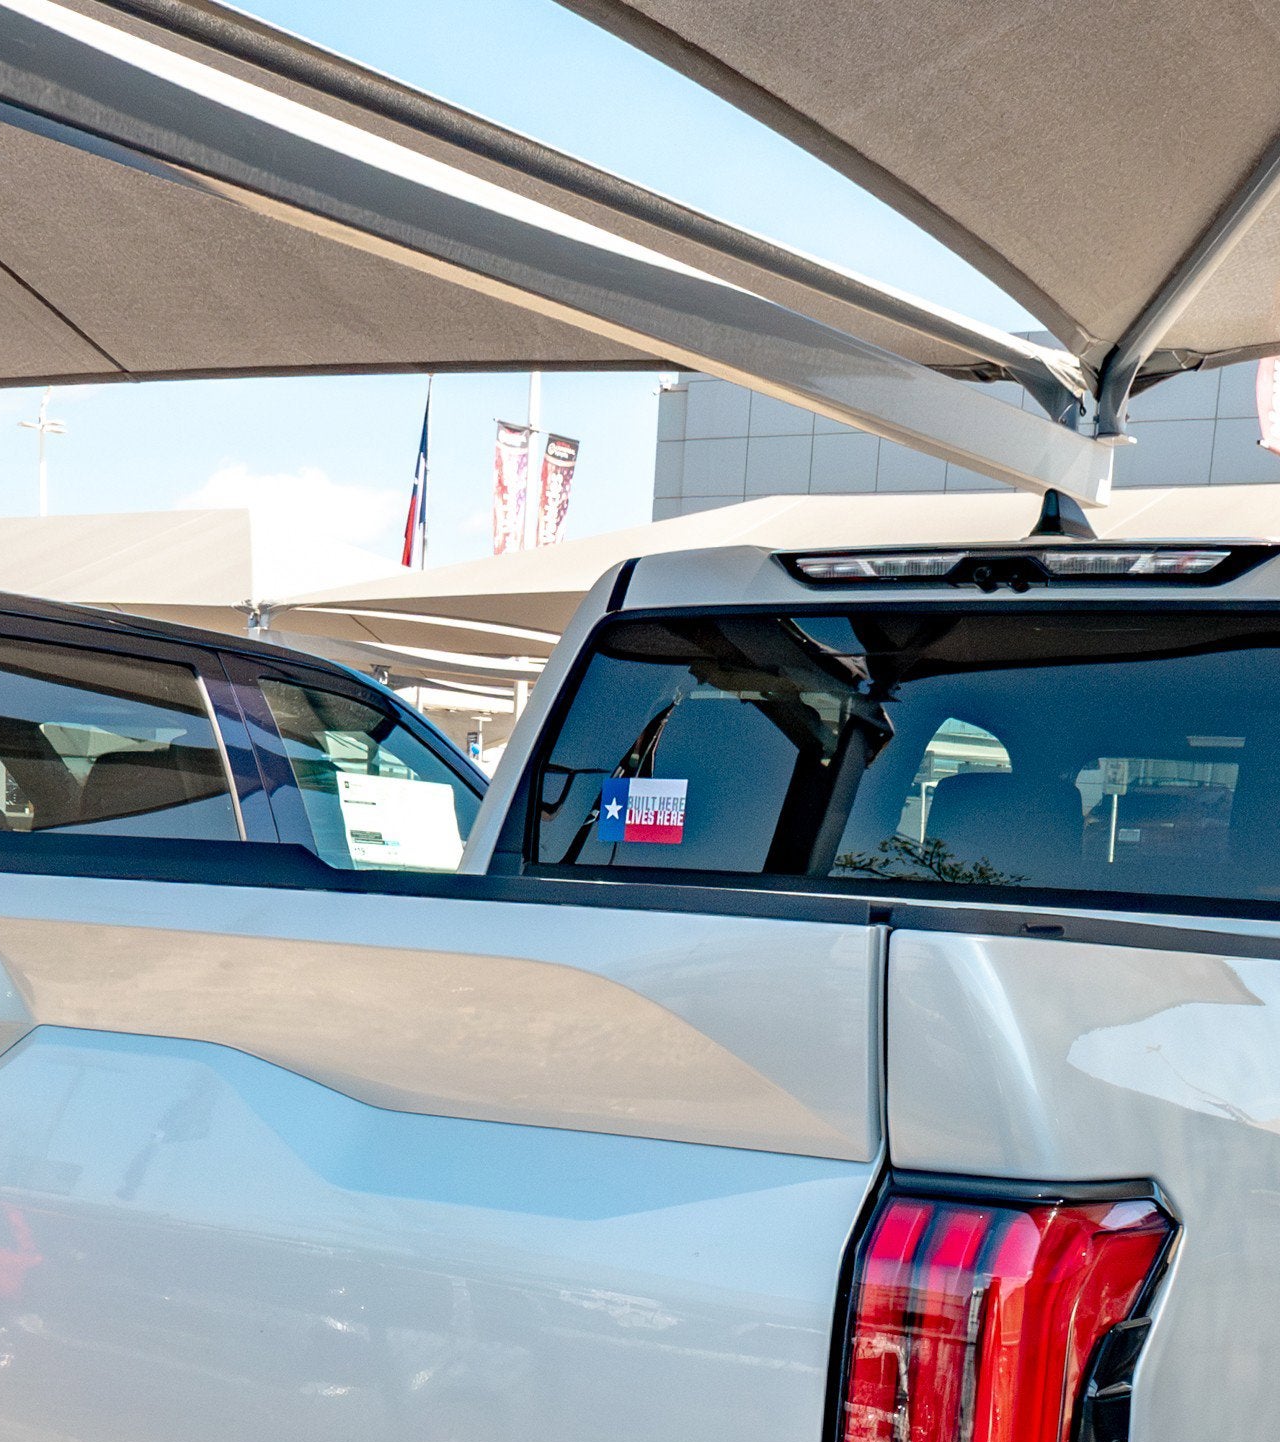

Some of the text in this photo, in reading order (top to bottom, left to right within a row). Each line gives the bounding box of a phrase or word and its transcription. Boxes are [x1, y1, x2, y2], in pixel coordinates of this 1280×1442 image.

[628, 796, 686, 812] BUILT HERE
[625, 809, 684, 826] LIVES HERE
